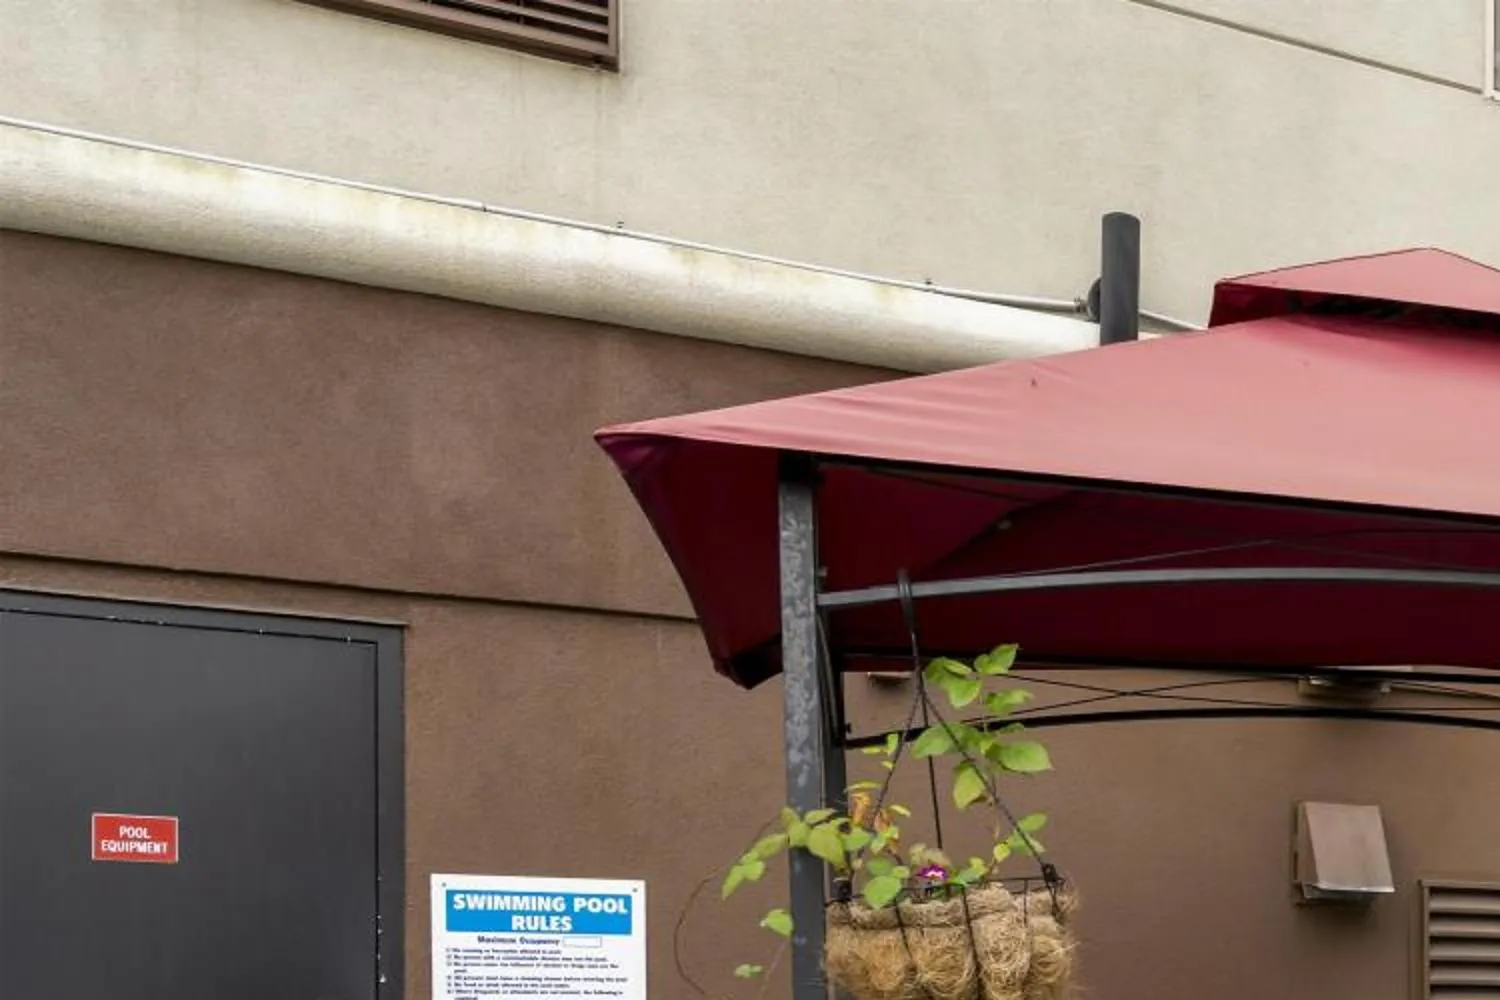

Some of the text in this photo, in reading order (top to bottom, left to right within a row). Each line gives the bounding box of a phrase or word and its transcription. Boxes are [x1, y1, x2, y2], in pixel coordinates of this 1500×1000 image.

[119, 826, 152, 839] POOL
[101, 839, 168, 854] EQUIPMENT
[453, 893, 628, 915] SWIMMING POOL
[511, 914, 574, 931] RULES
